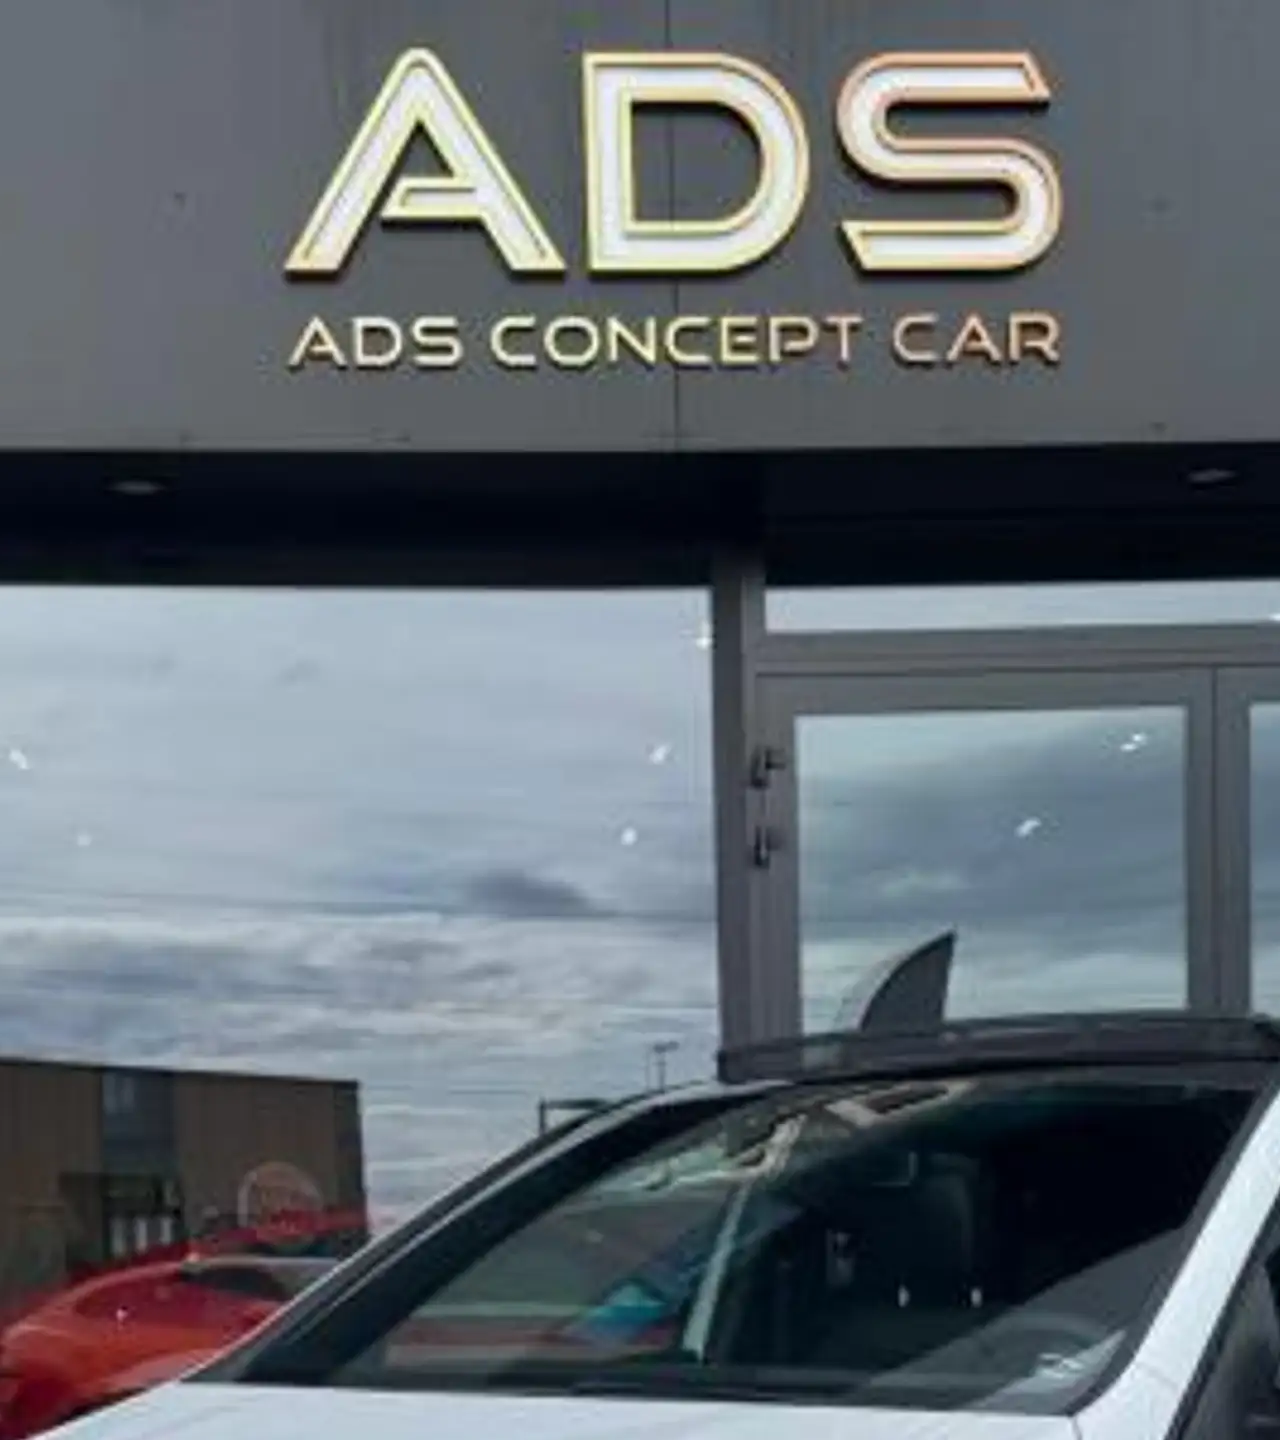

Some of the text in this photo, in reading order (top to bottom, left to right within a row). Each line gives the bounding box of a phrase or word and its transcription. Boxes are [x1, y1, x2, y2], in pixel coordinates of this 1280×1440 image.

[284, 47, 1062, 272] ADS
[287, 312, 1063, 368] ADS CONCEPT CAR
